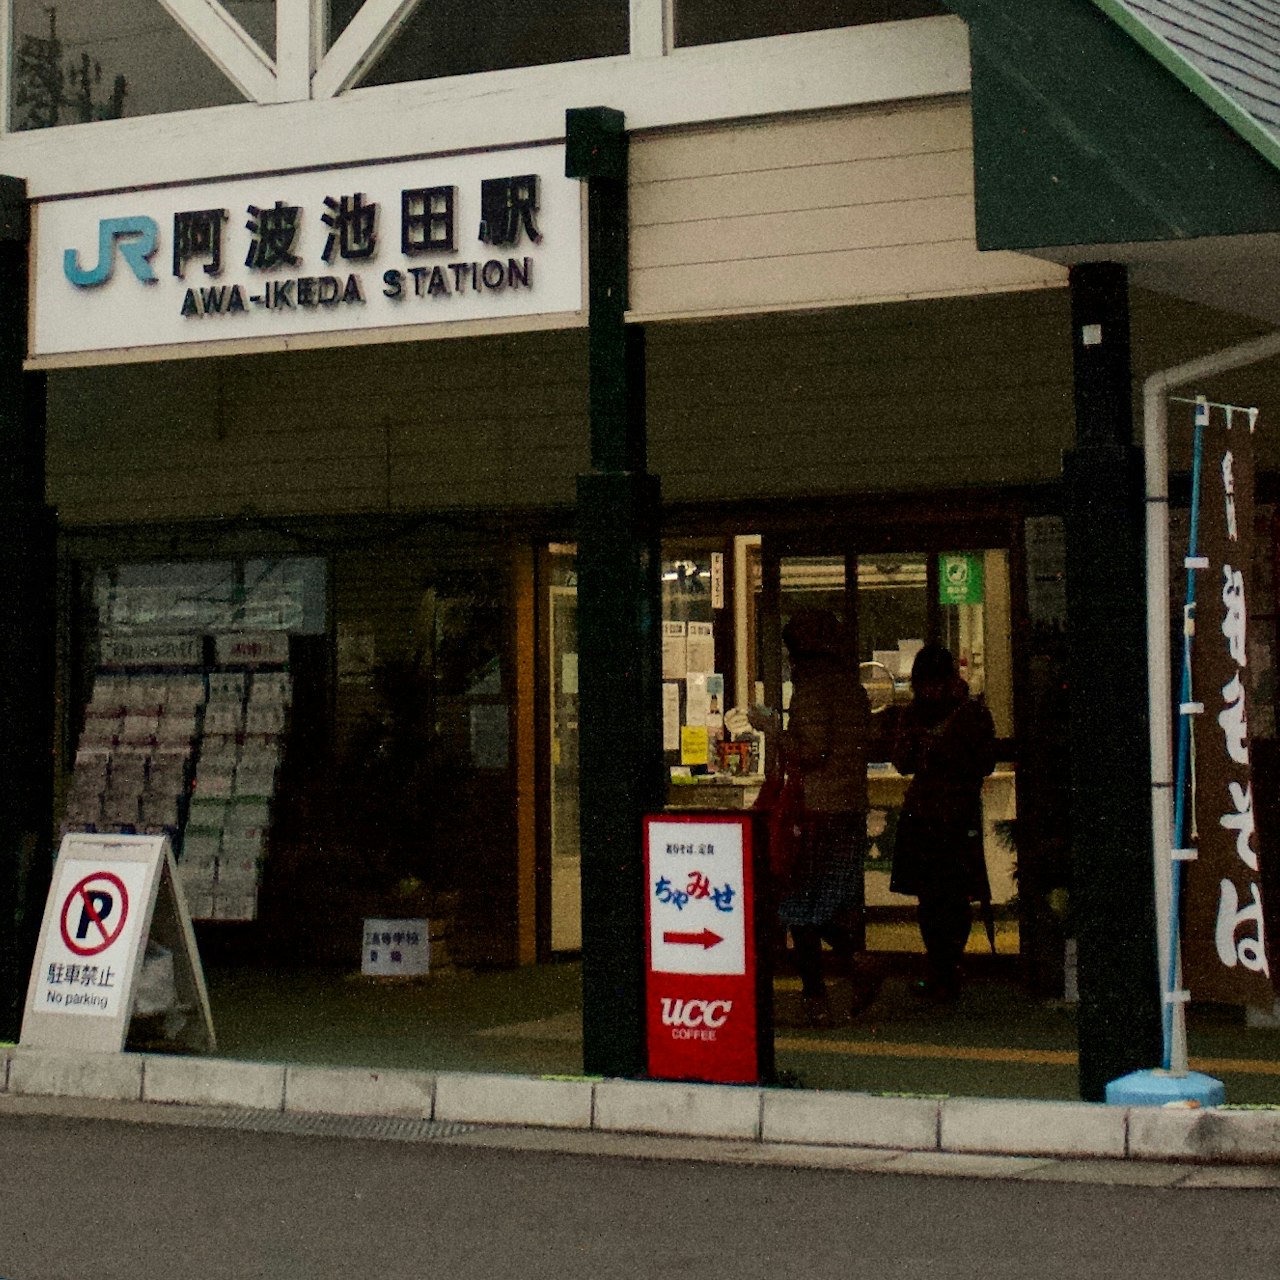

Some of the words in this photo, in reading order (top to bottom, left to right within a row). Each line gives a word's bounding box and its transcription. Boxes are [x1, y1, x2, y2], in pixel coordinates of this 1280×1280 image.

[64, 214, 160, 287] JR
[173, 173, 542, 279] 阿波池田駅
[180, 272, 365, 318] AWA-IKEDA
[382, 256, 534, 299] STATION
[655, 870, 736, 913] ちゃみせ
[47, 963, 115, 988] 駐車禁止
[46, 989, 63, 1004] No
[65, 990, 109, 1009] parking
[661, 997, 732, 1028] UCC
[671, 1028, 717, 1041] COFFEE
